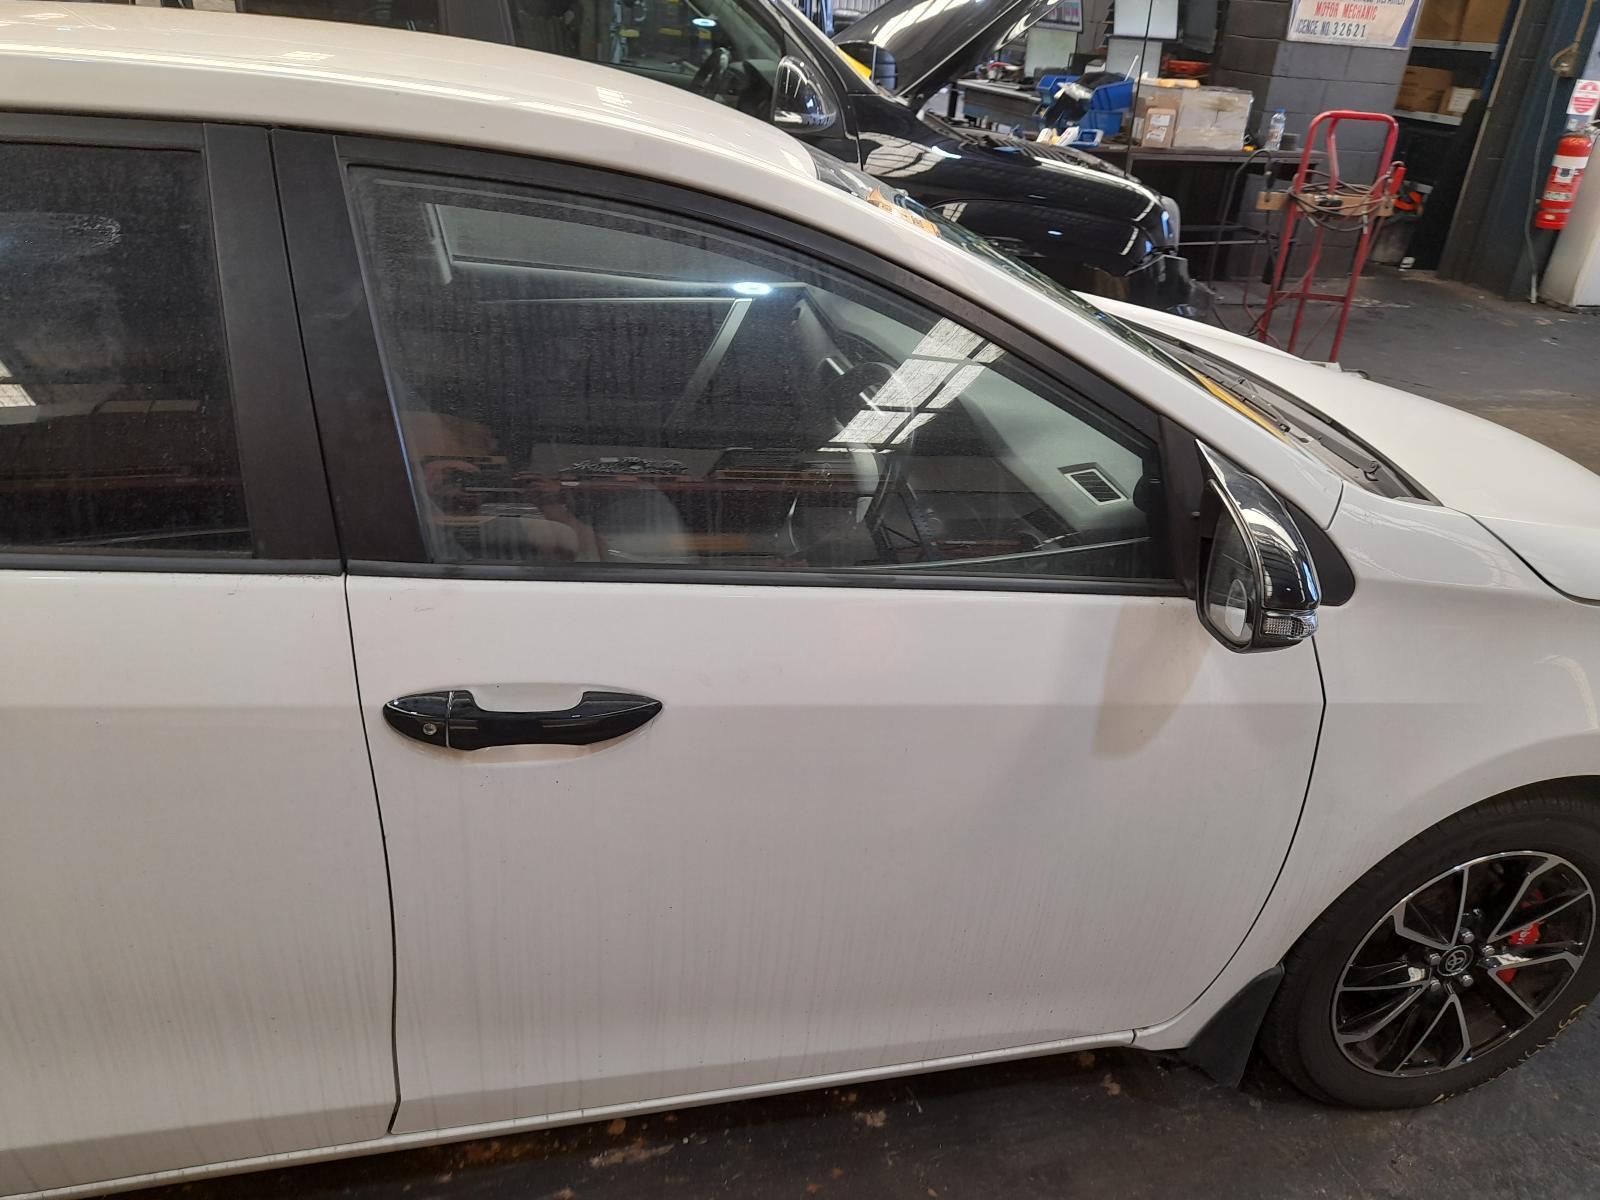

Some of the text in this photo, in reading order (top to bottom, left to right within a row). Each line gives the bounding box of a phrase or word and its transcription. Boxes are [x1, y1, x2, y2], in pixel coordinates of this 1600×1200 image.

[1314, 1, 1378, 20] MOTOR MECHANIC
[1332, 21, 1367, 37] 32621
